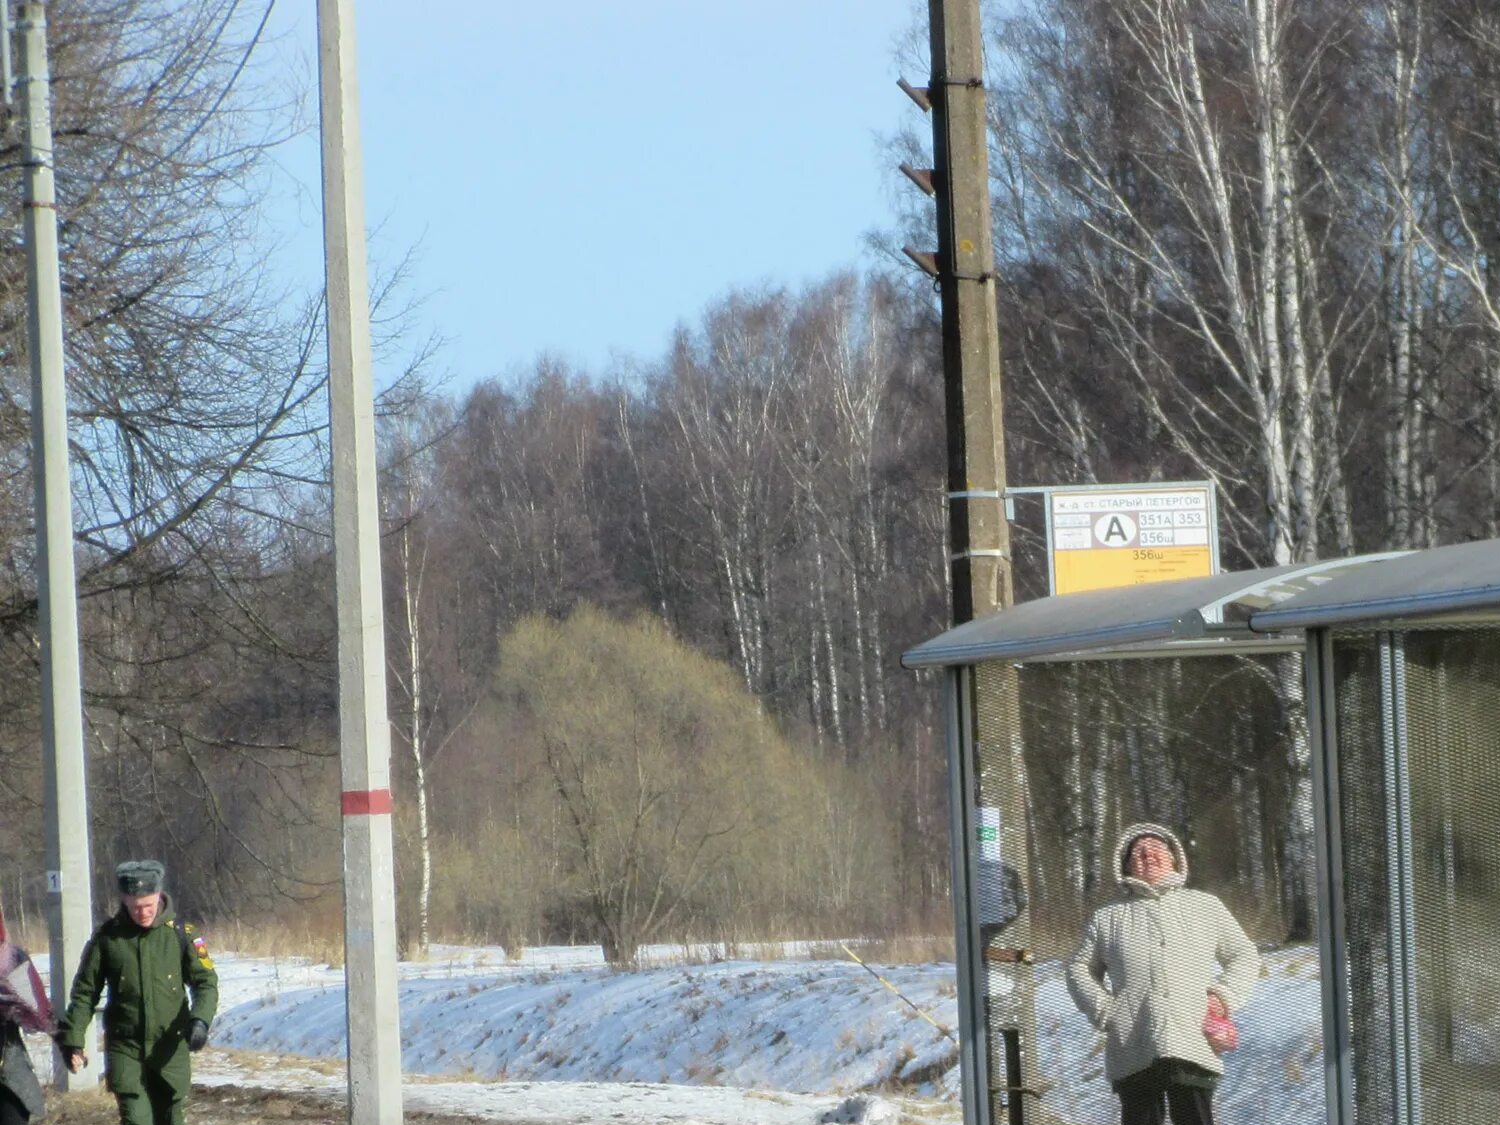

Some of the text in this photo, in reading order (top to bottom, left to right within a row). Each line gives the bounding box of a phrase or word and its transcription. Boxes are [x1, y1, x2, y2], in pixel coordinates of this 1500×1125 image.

[1098, 496, 1143, 509] СТАРЫЙ
[1145, 496, 1201, 508] ПЕТЕРГОФ
[1178, 512, 1202, 525] 353
[1141, 532, 1174, 544] 356ш
[1132, 549, 1164, 561] 356ш
[50, 874, 57, 888] 1
